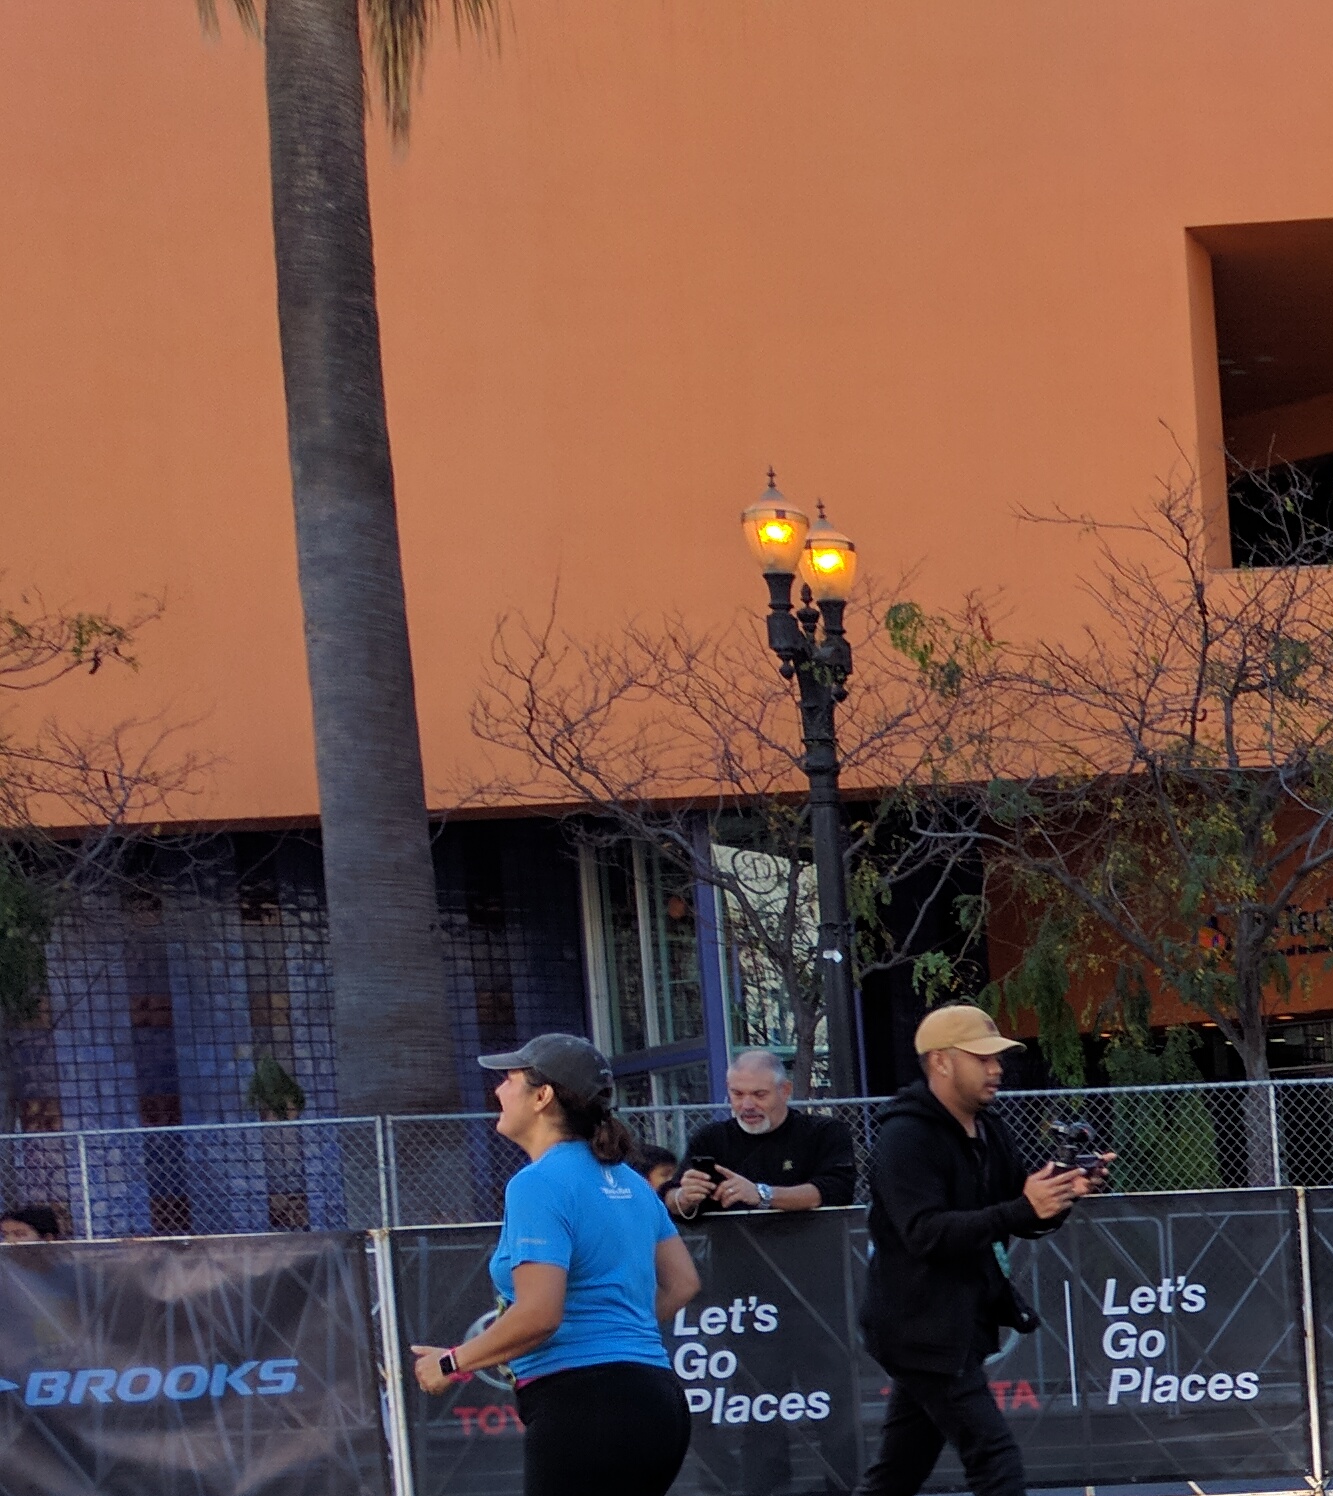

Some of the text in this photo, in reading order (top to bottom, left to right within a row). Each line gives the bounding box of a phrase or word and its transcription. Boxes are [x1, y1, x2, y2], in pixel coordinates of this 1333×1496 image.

[1102, 1275, 1207, 1316] Let's
[673, 1295, 779, 1336] Let's
[1102, 1321, 1166, 1360] Go
[673, 1342, 738, 1381] Go
[25, 1358, 300, 1407] BROOKS
[1107, 1366, 1260, 1405] Places
[452, 1404, 527, 1437] TOY
[684, 1387, 831, 1425] Places
